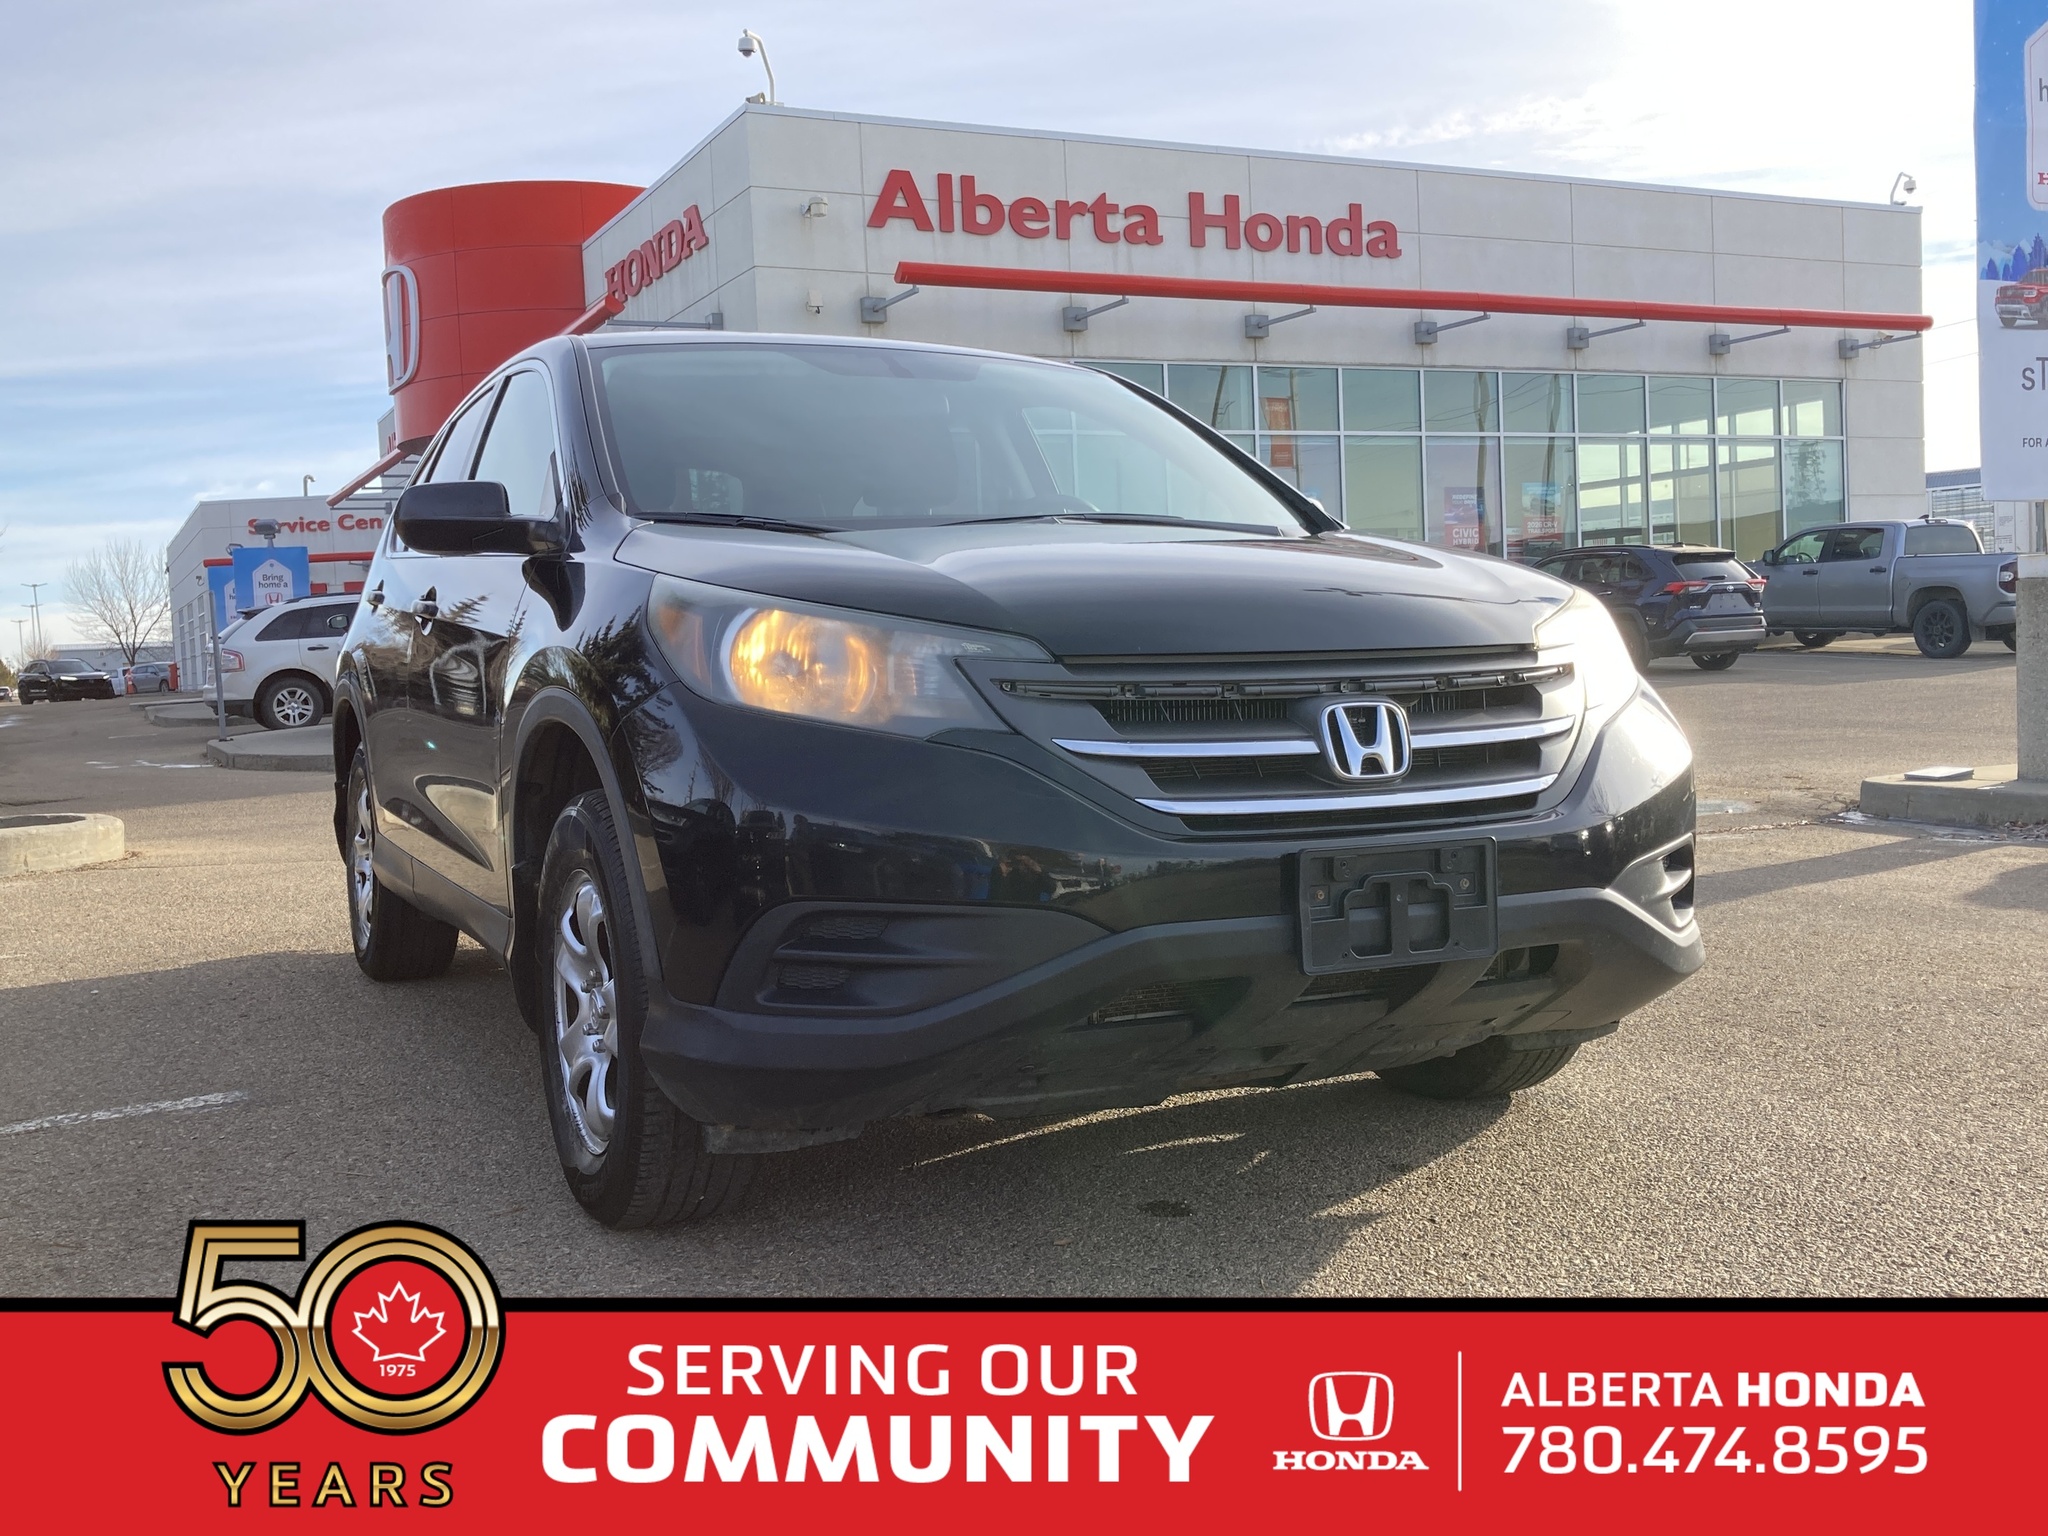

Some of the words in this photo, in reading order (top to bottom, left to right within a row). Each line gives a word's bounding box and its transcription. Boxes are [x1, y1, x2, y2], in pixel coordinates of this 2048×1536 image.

[867, 169, 1163, 246] Alberta
[1189, 192, 1402, 259] Honda
[605, 204, 710, 304] HONDA
[2022, 437, 2042, 448] FOR
[248, 516, 330, 535] Srvice
[337, 514, 384, 530] Cen
[1452, 528, 1479, 538] CIVIC
[262, 574, 284, 582] Bring
